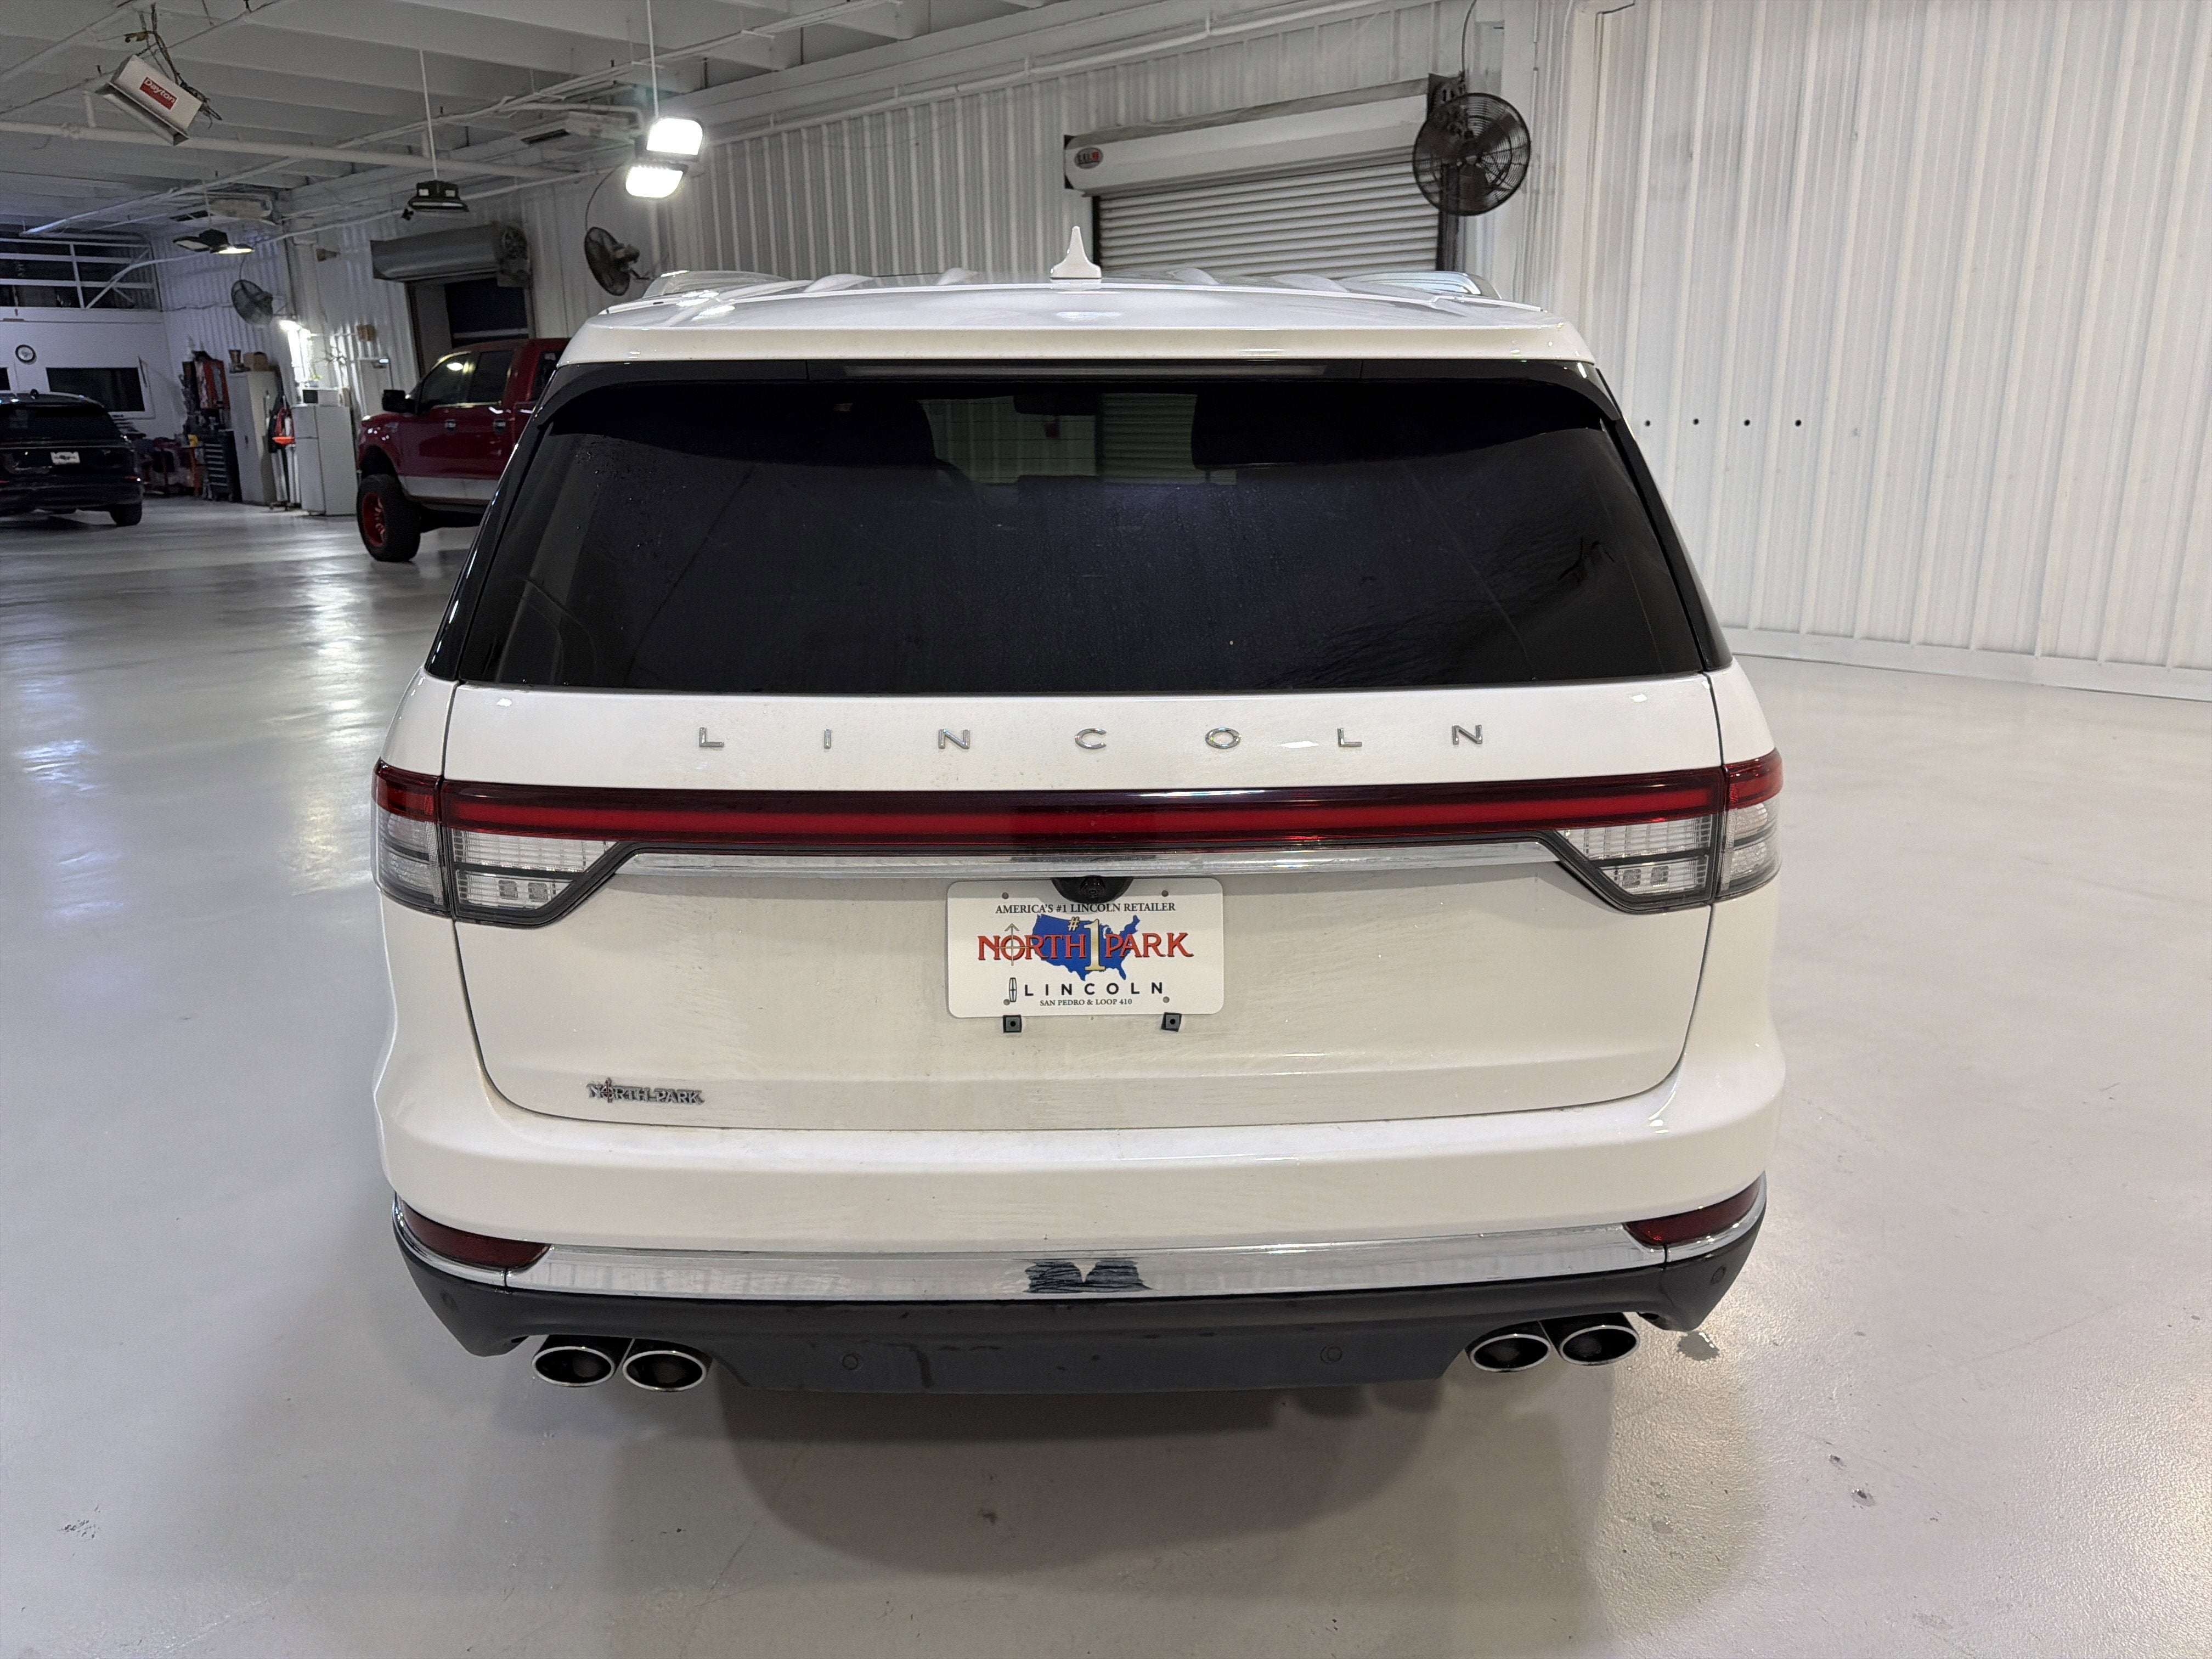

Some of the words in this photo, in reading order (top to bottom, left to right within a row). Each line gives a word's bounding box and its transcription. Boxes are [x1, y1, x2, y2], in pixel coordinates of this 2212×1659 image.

[144, 77, 177, 103] Dayton
[698, 725, 1483, 750] LINCOLN
[995, 903, 1053, 913] AMERICA'S
[1056, 904, 1067, 913] #1
[1070, 903, 1121, 913] LINCOLN
[1124, 902, 1176, 912] RETAILER
[978, 934, 1086, 961] NORTH
[1105, 932, 1194, 958] PARK
[1024, 981, 1163, 996] LINCOLN
[586, 1083, 651, 1102] NORTH
[653, 1088, 704, 1105] PARK
